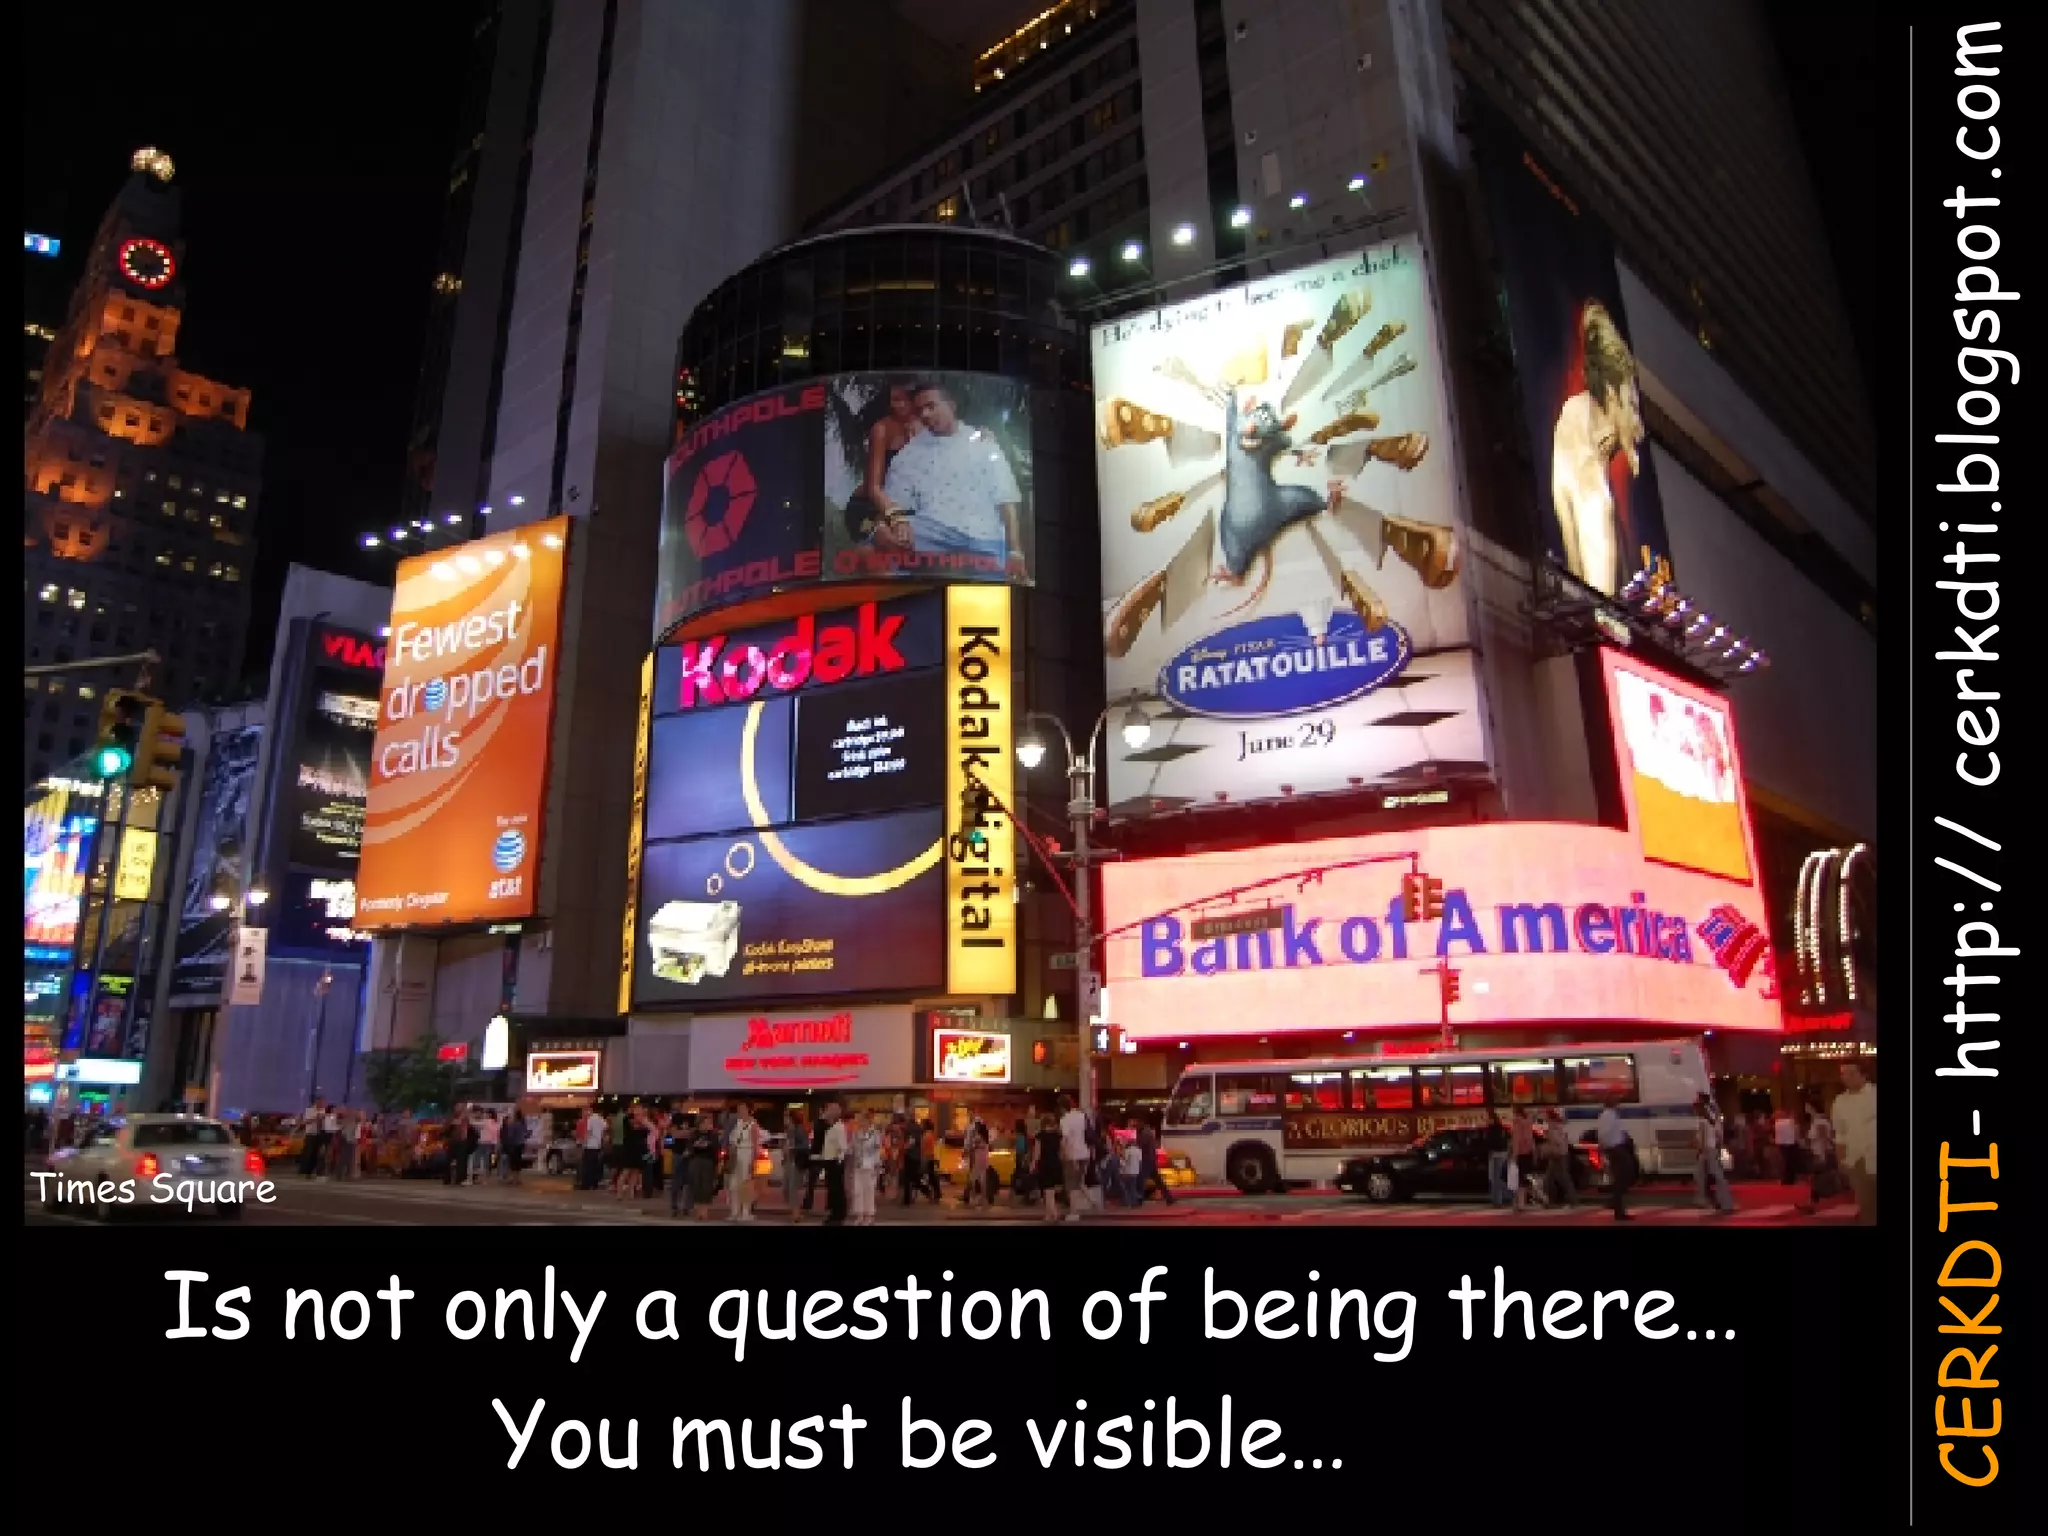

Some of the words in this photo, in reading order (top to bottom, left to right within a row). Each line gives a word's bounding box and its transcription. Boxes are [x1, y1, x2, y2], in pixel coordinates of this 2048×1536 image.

[395, 603, 522, 666] Fewest
[679, 600, 907, 709] Kodak
[1177, 635, 1389, 694] RATATOUILLE
[387, 644, 546, 720] dropped
[958, 627, 1001, 772] Kodak
[380, 725, 460, 778] calls
[1238, 731, 1294, 762] June
[1297, 718, 1336, 748] 29
[1142, 903, 1323, 978] Bank
[1340, 892, 1408, 964] of
[1435, 887, 1695, 964] America
